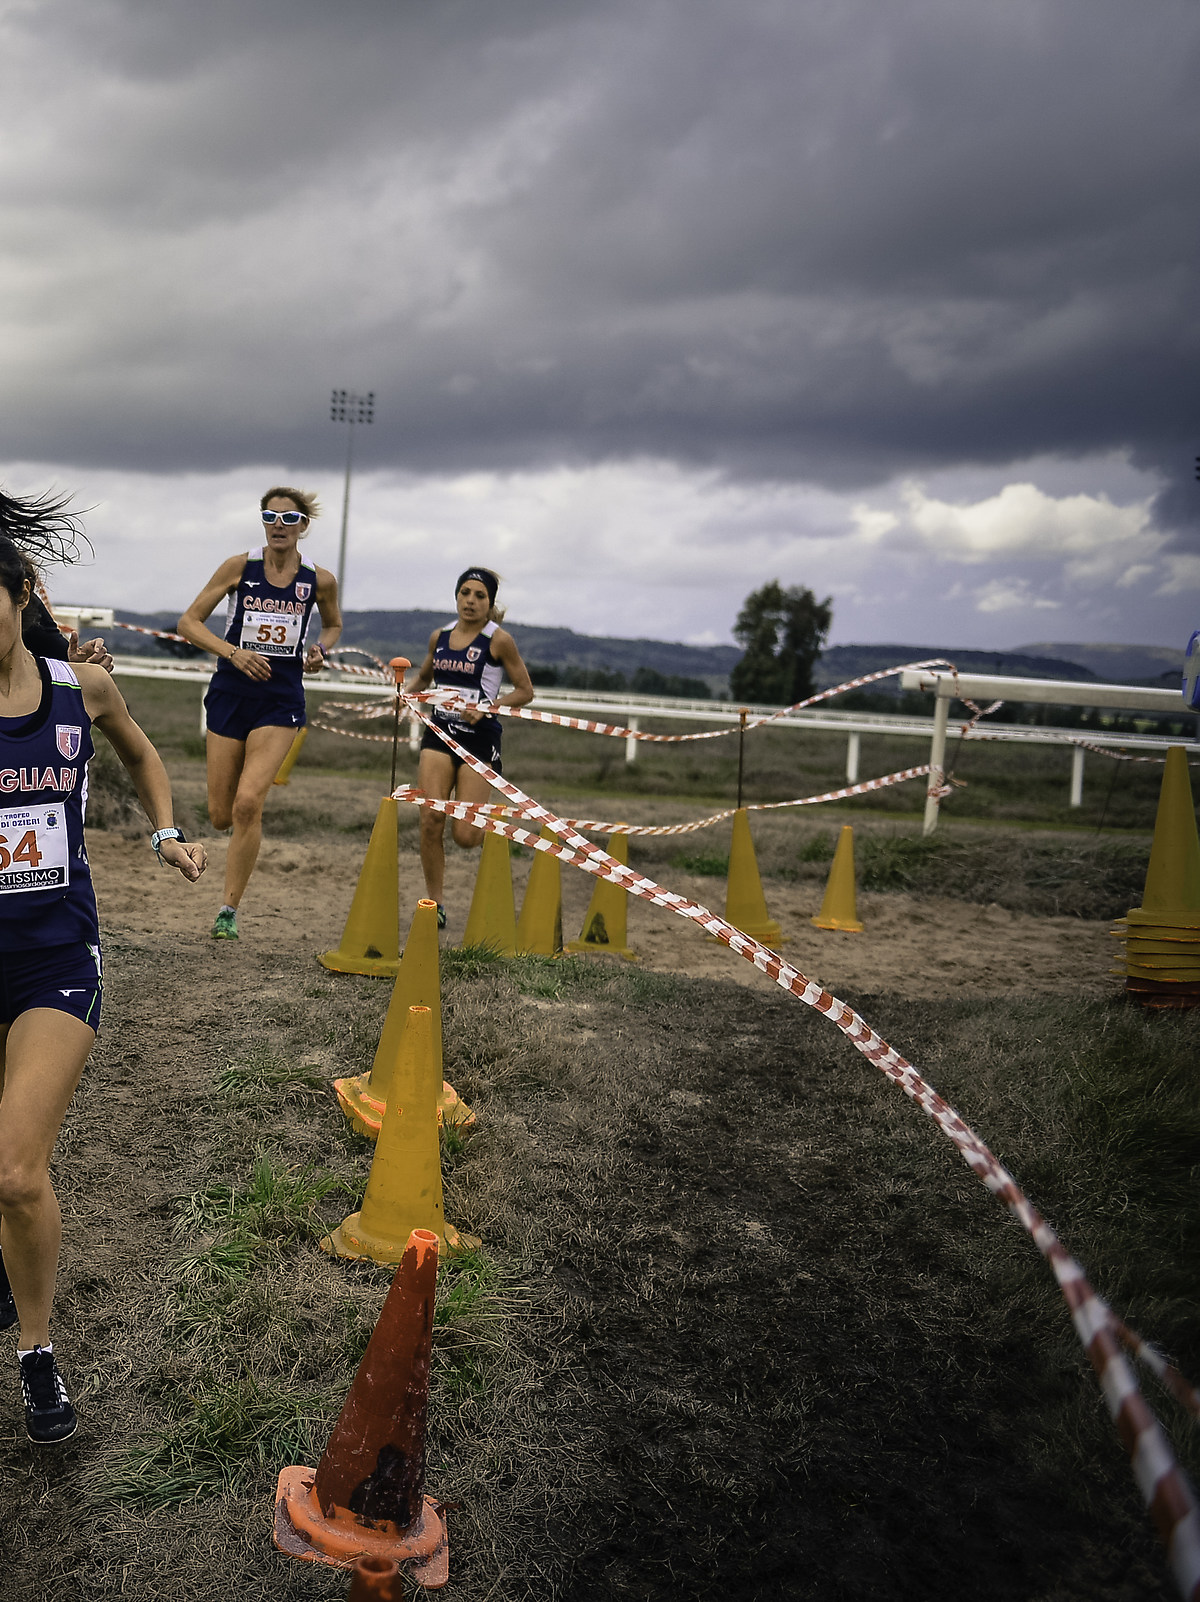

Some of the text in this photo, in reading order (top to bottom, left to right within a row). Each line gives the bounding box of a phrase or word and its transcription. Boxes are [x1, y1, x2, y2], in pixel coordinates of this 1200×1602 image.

[243, 595, 306, 616] CAGLIARI
[256, 624, 287, 644] 53
[1, 821, 10, 829] DI
[12, 818, 40, 827] OZIERI
[4, 812, 30, 821] TROFEO
